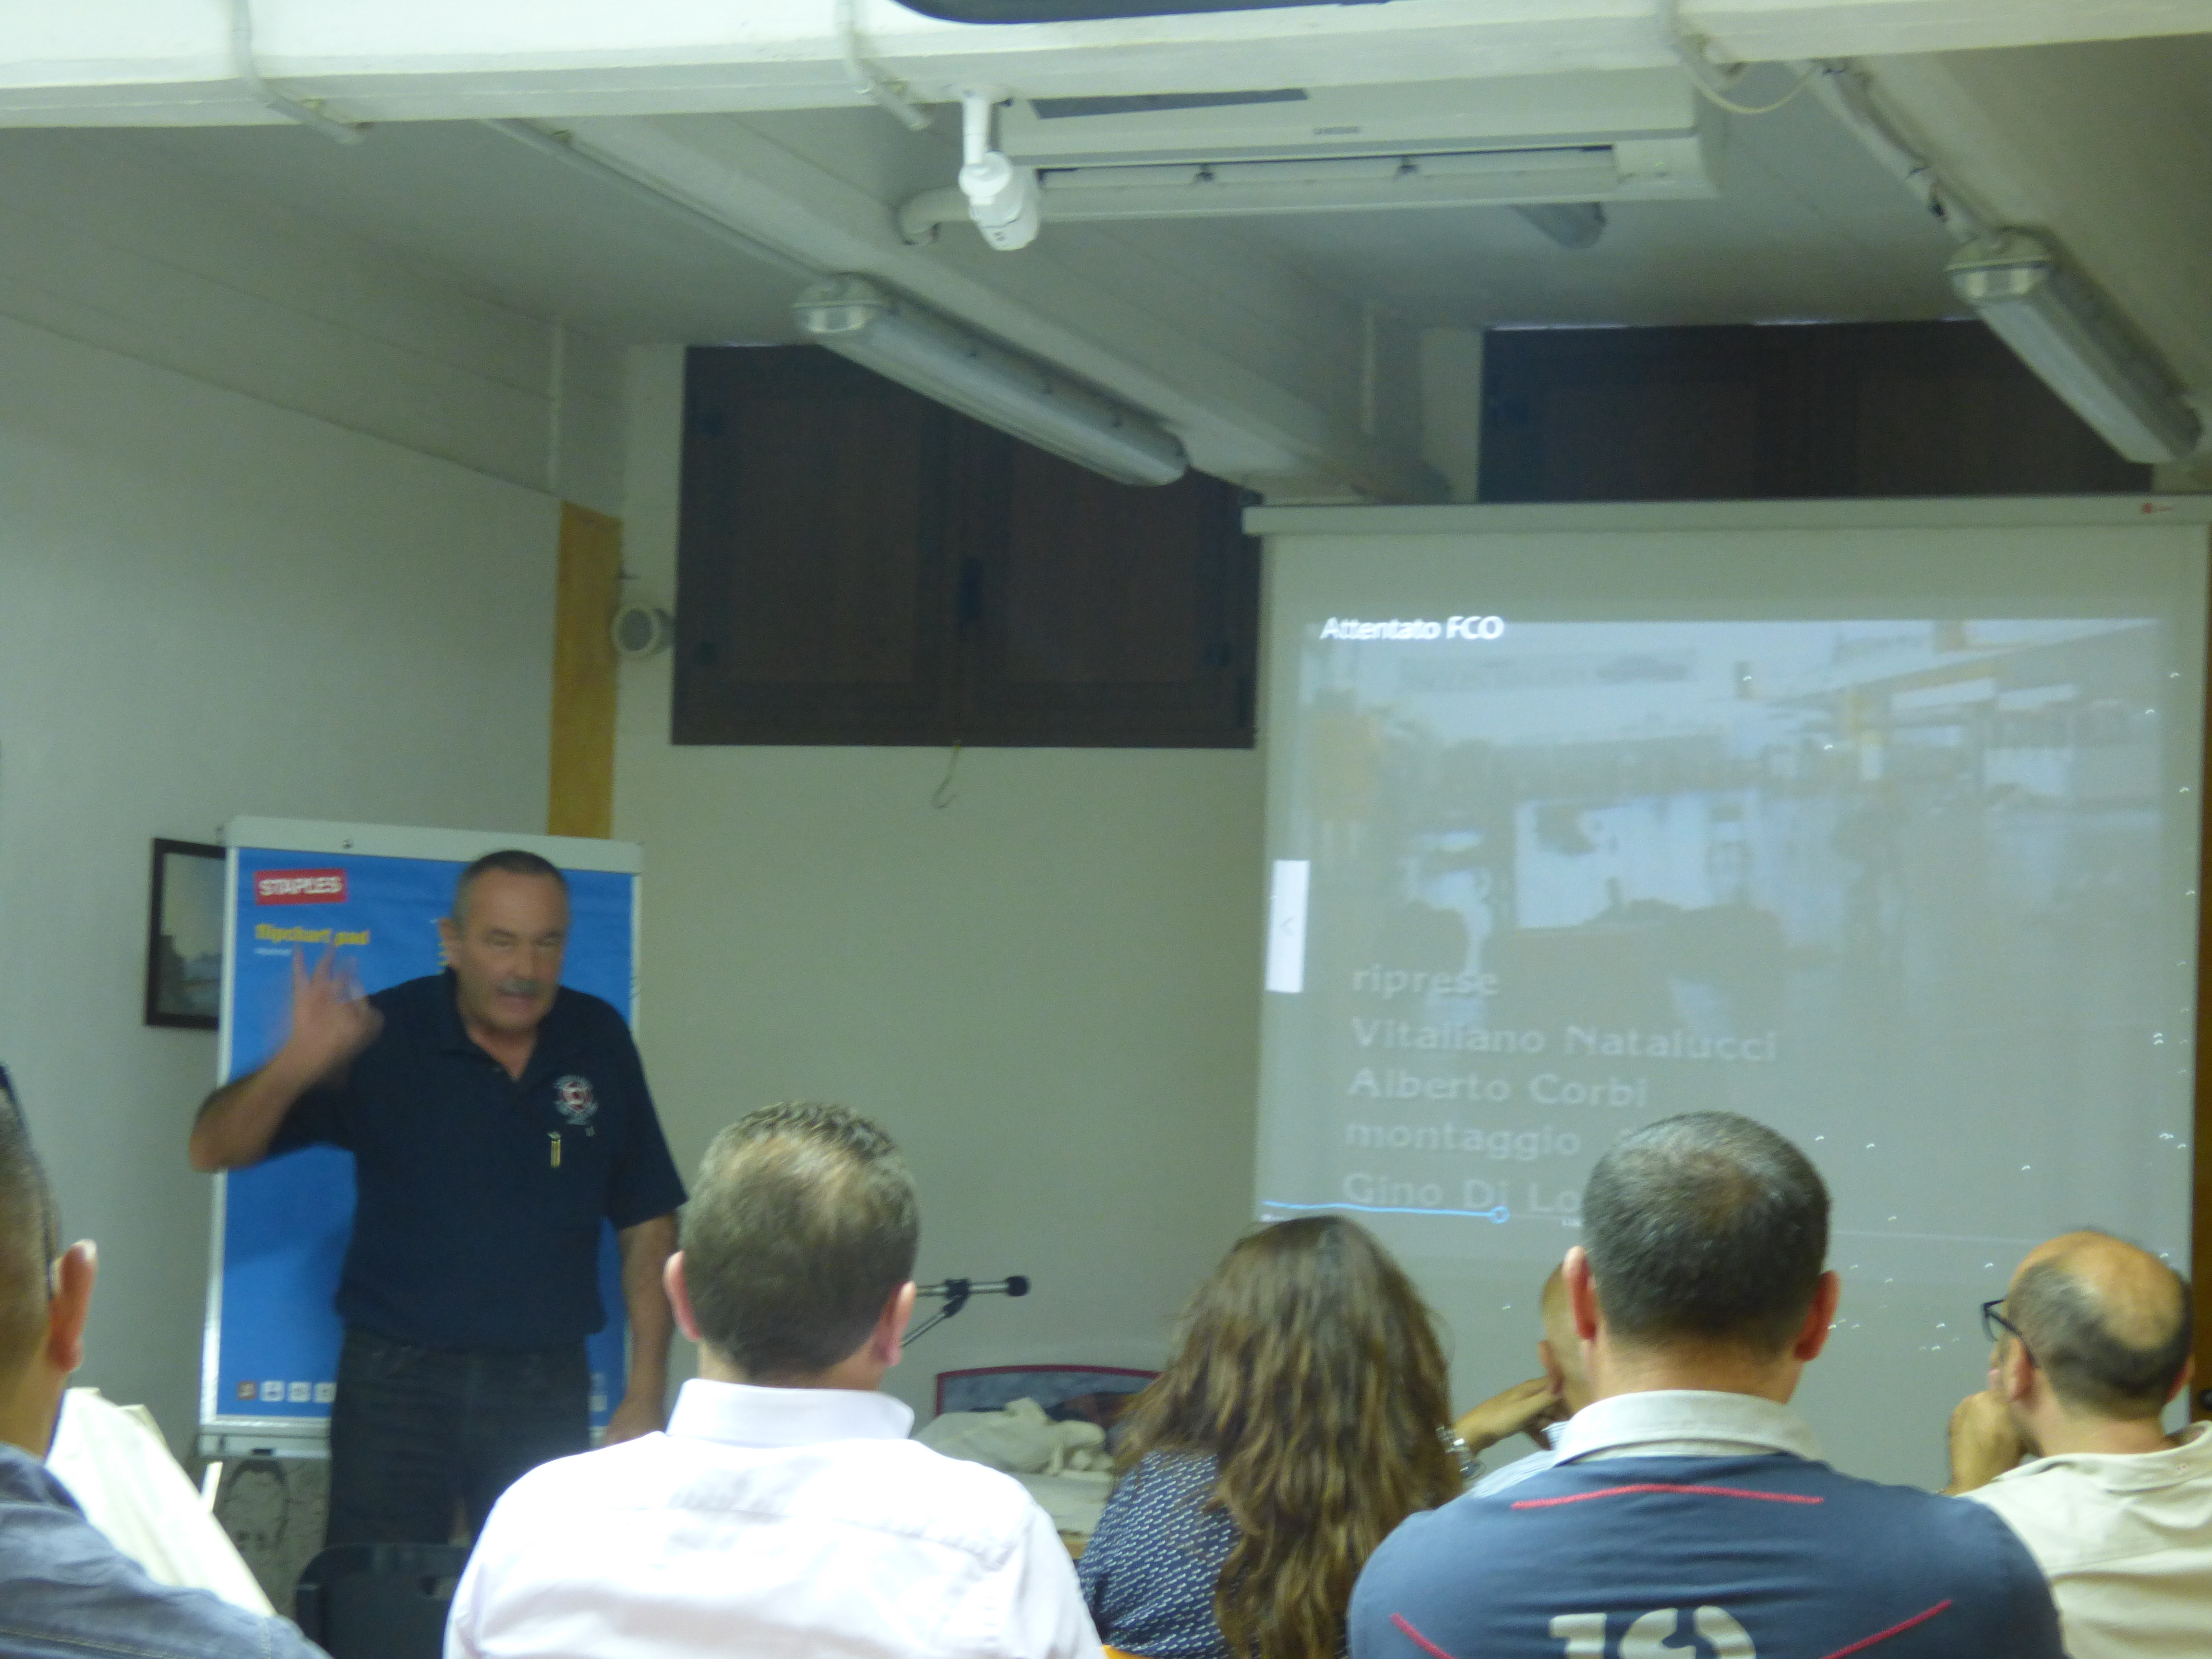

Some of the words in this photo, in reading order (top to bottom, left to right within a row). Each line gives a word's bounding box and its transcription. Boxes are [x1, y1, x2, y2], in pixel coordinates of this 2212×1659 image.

[1319, 616, 1441, 640] Attentato
[1445, 615, 1505, 639] FCO
[258, 876, 343, 896] STAPLES
[1351, 963, 1499, 999] riprese
[1350, 1015, 1546, 1054] Vitaliano
[1564, 1024, 1777, 1061] Natalucci
[1347, 1067, 1511, 1102] Alberto
[1527, 1072, 1648, 1108] Corbi
[1346, 1121, 1581, 1162] montaggio
[1343, 1172, 1442, 1206] Gino
[1463, 1178, 1509, 1210] Di
